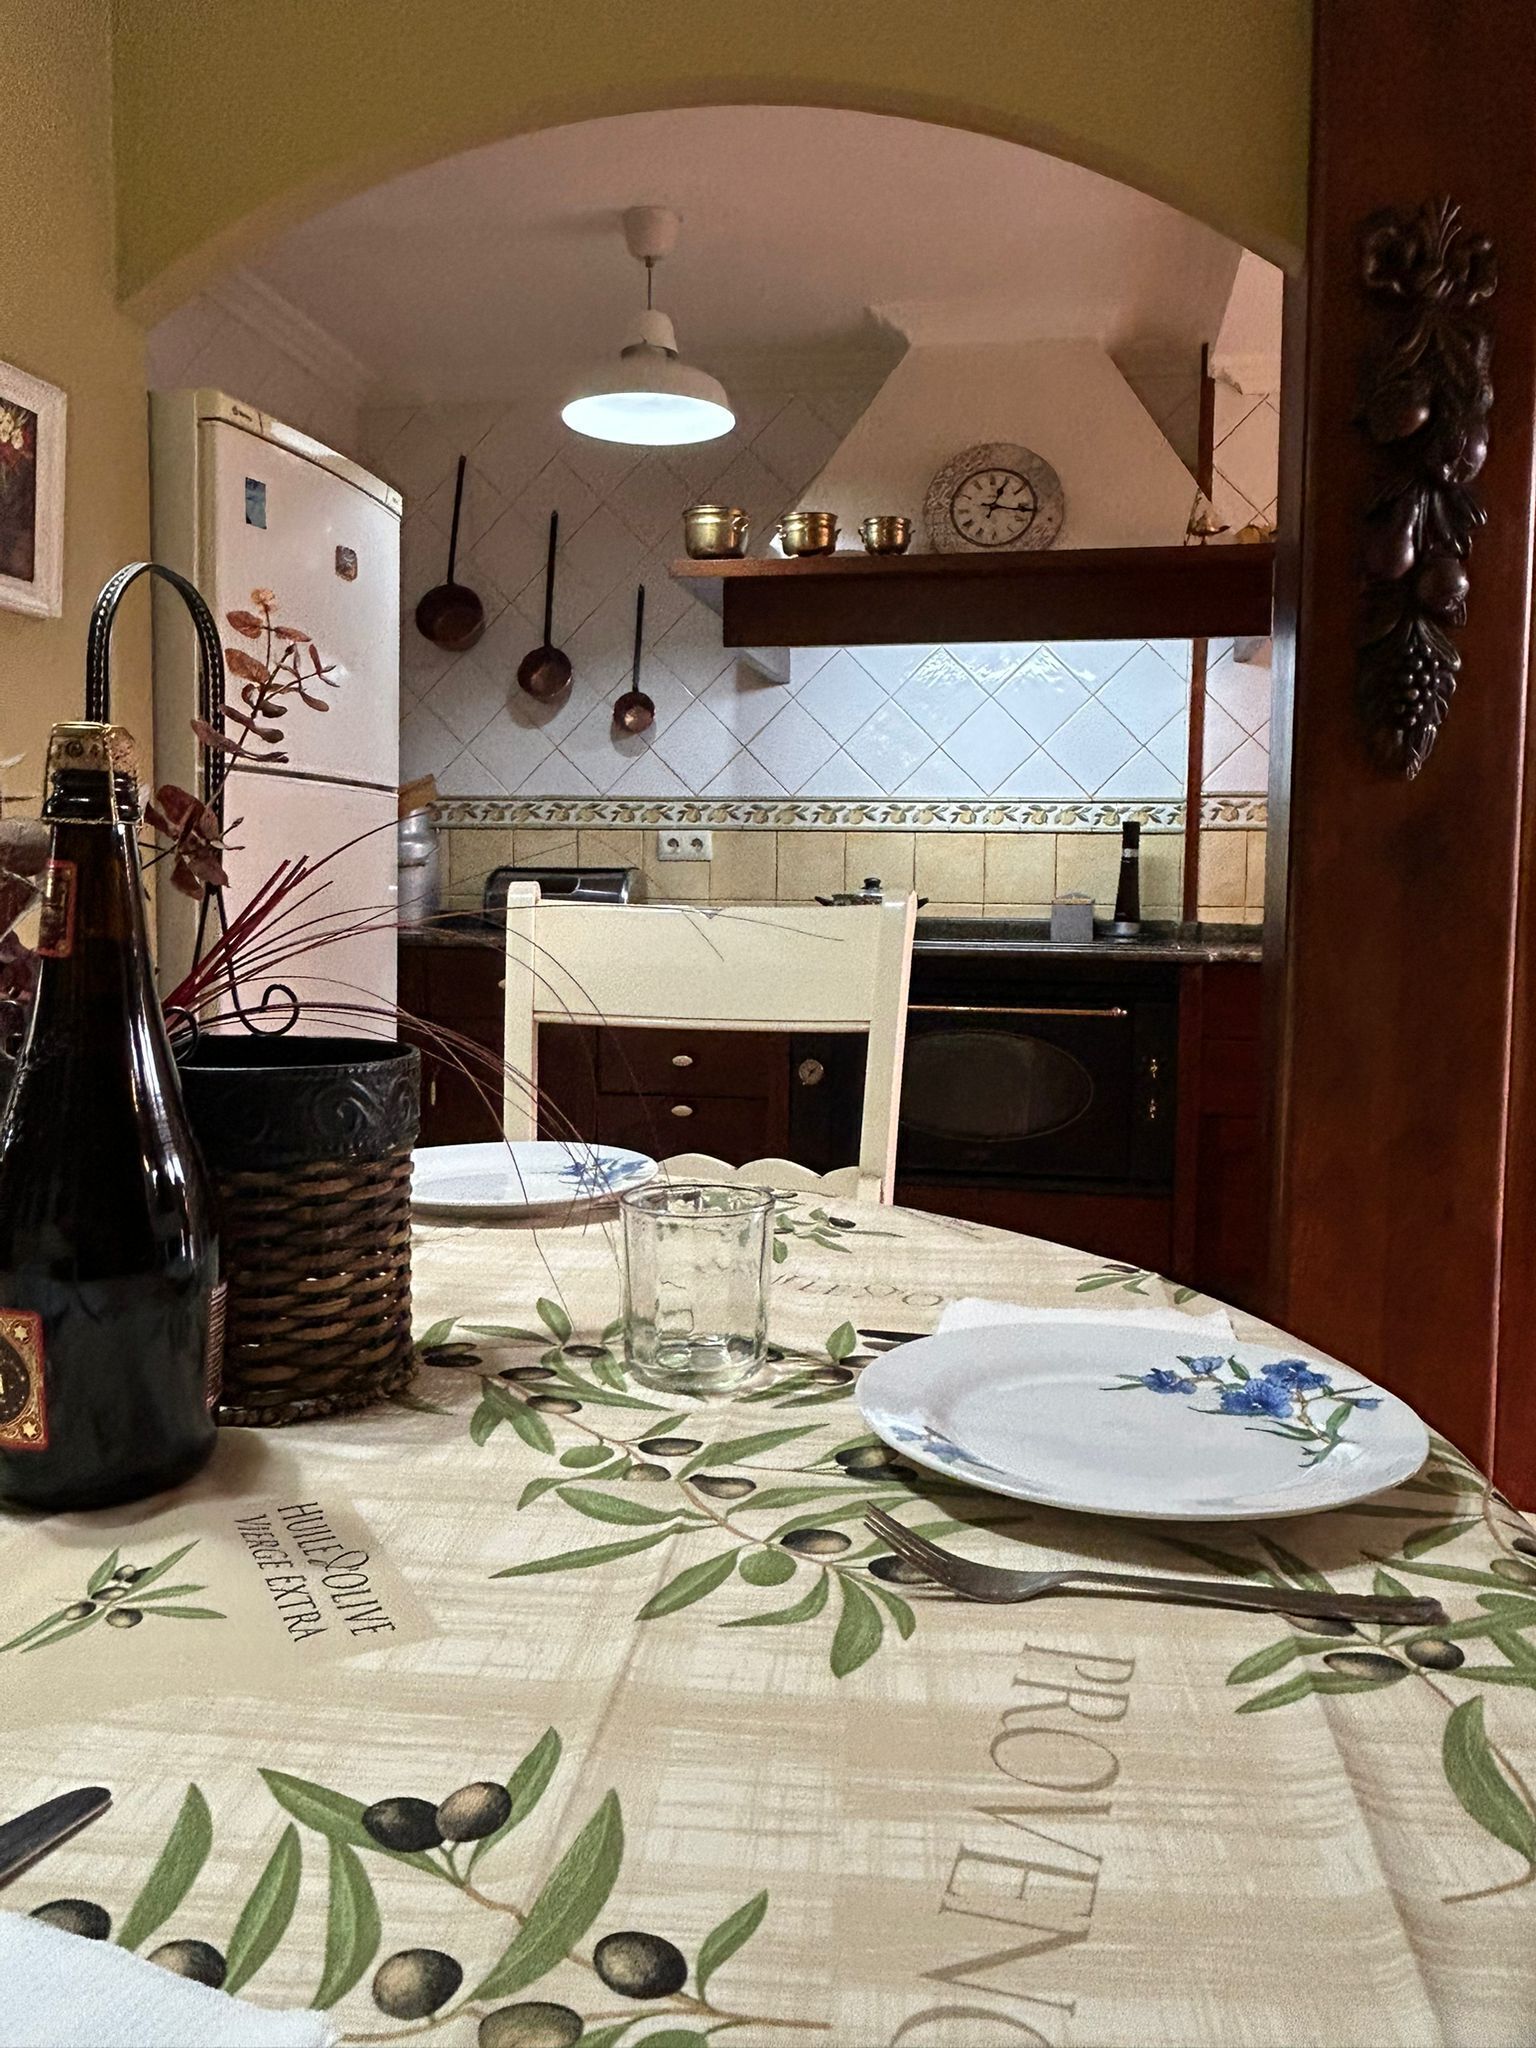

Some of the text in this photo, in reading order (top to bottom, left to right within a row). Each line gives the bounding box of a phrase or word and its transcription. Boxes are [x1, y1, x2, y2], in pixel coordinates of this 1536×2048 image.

[277, 1501, 344, 1556] HUILE
[234, 1513, 329, 1642] VIERGE EXTRA
